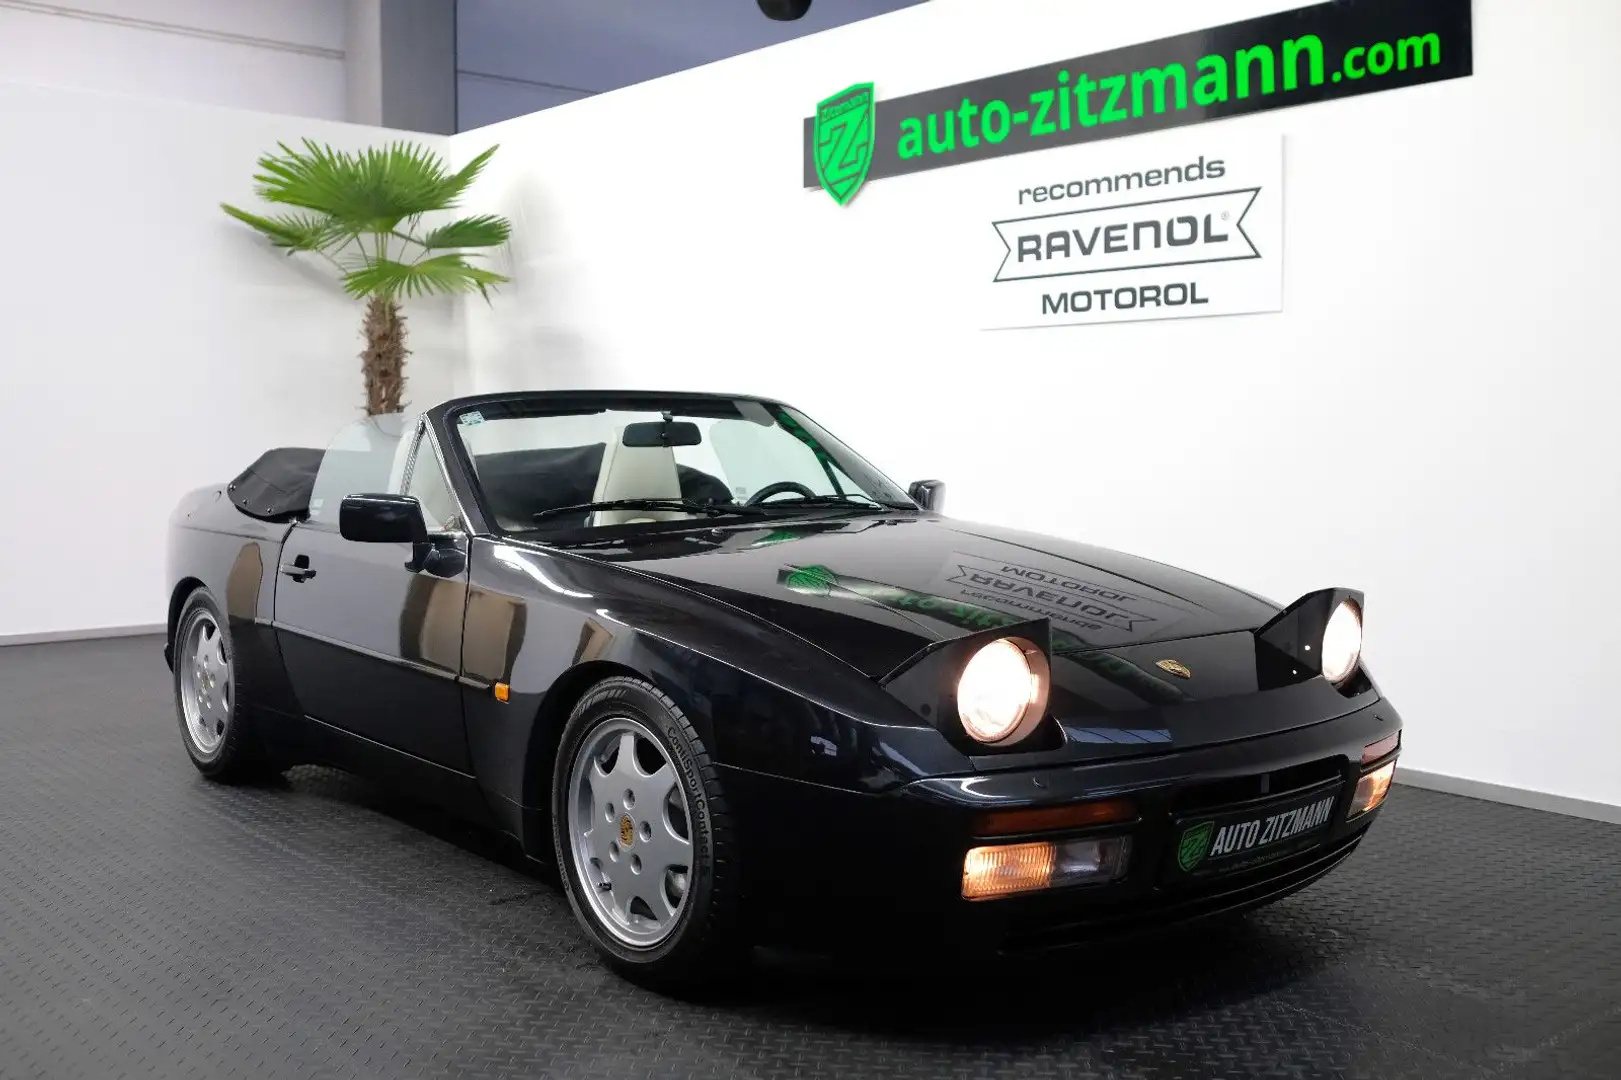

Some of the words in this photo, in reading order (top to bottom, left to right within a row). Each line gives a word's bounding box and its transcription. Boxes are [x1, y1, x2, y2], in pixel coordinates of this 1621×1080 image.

[897, 31, 1441, 159] auto-zitzmann.com
[1018, 156, 1226, 205] recommends
[1042, 282, 1209, 315] MOTOROL
[1210, 819, 1261, 857] AUTO
[1258, 795, 1335, 845] ZITZMANN
